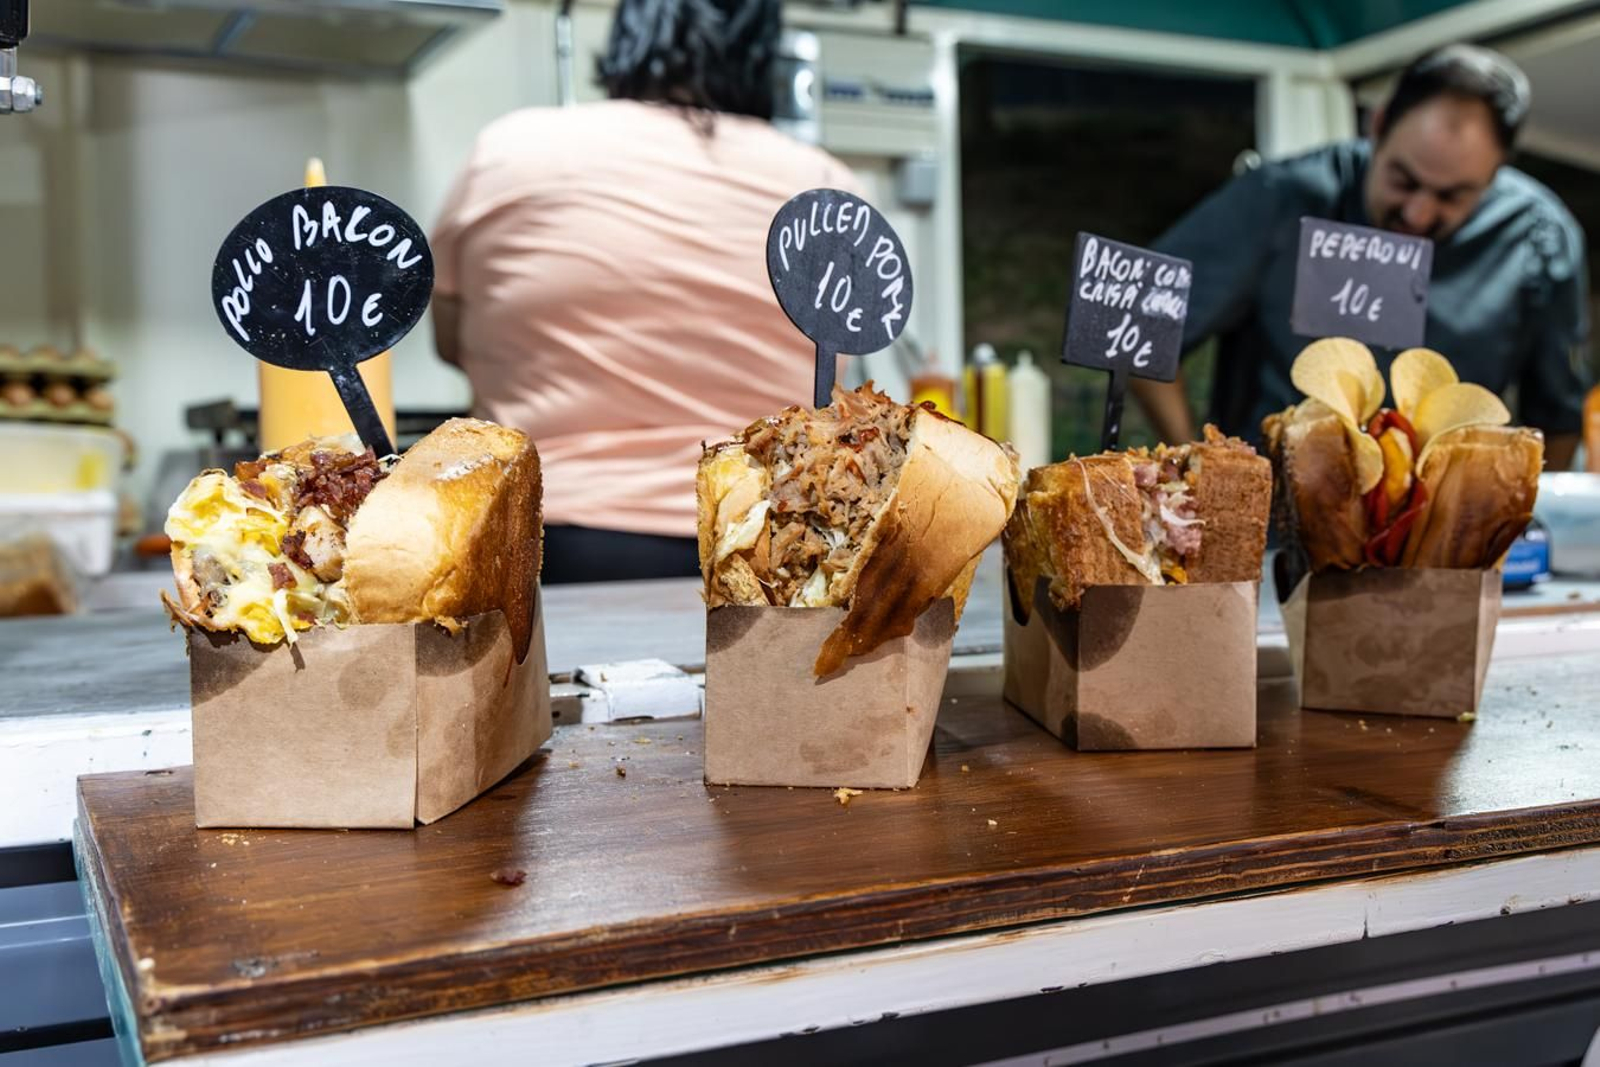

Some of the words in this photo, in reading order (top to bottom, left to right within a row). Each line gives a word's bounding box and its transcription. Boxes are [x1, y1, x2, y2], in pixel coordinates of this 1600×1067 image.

[221, 238, 274, 342] POLLO
[292, 200, 423, 270] BACON
[865, 235, 904, 341] PORK
